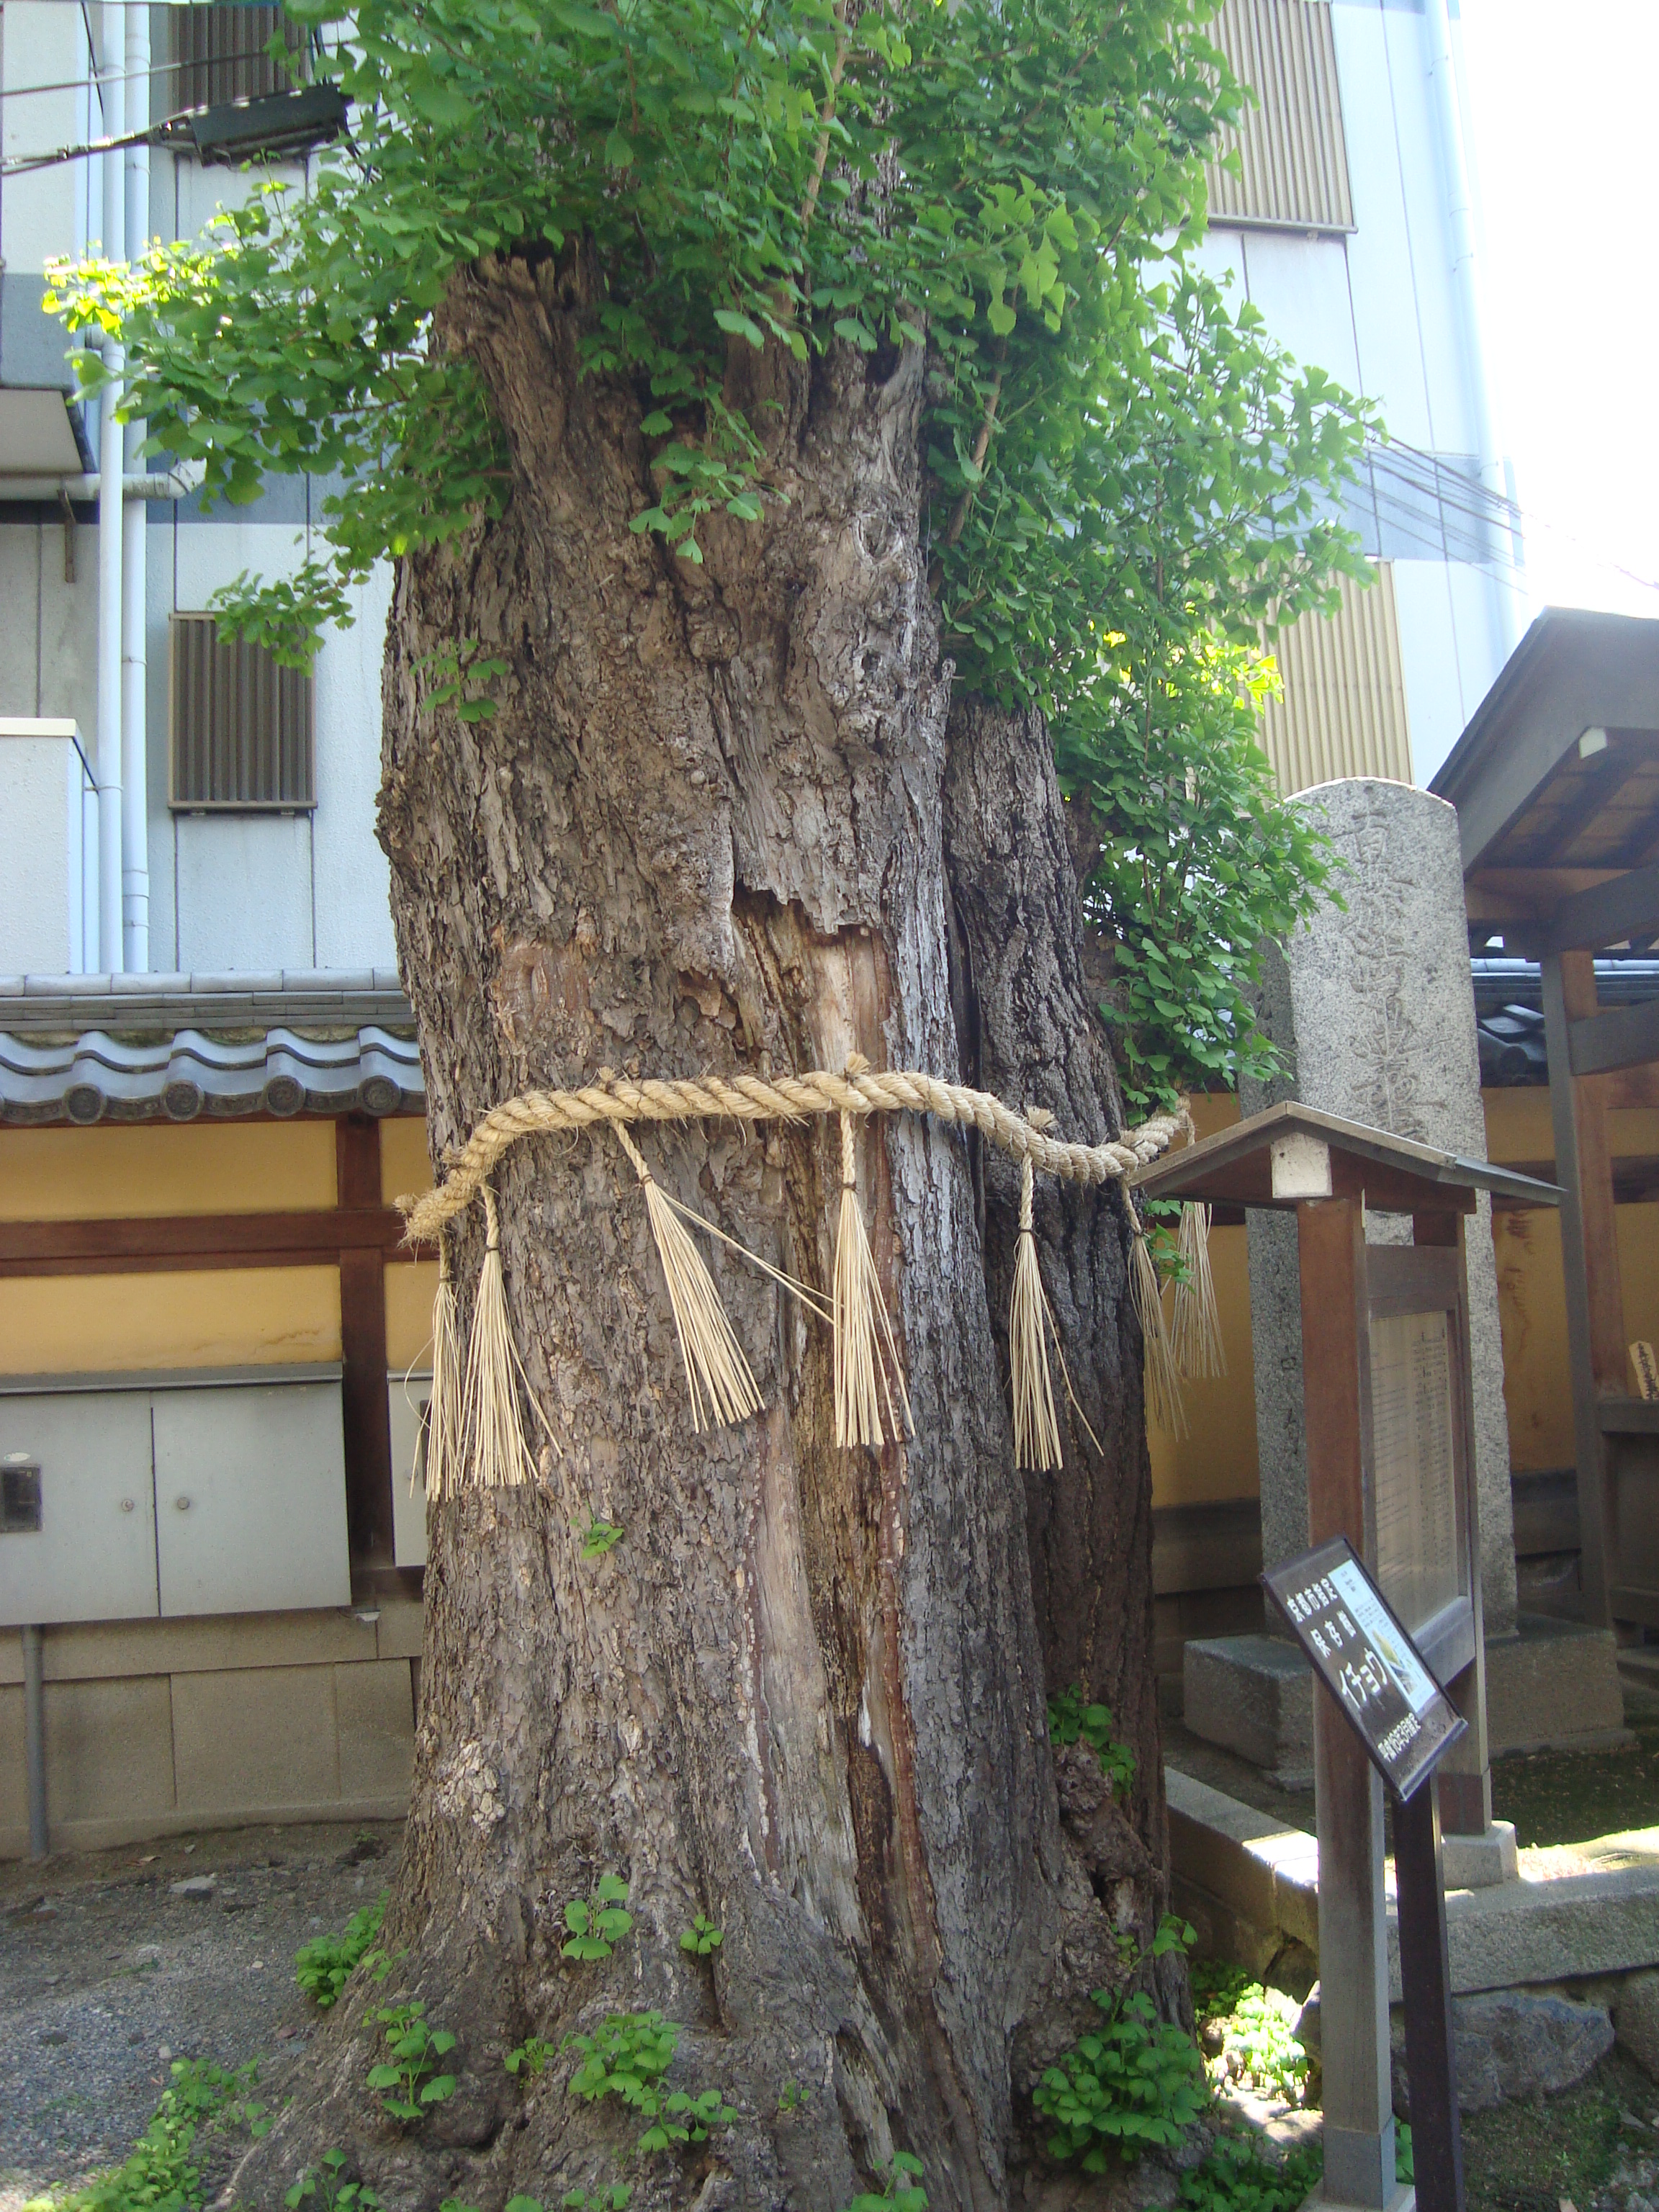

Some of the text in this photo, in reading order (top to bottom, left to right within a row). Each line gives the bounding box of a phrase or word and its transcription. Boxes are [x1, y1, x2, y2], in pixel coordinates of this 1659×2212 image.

[1287, 1578, 1338, 1622] 京都市指定
[1339, 1647, 1389, 1709] イチョウ
